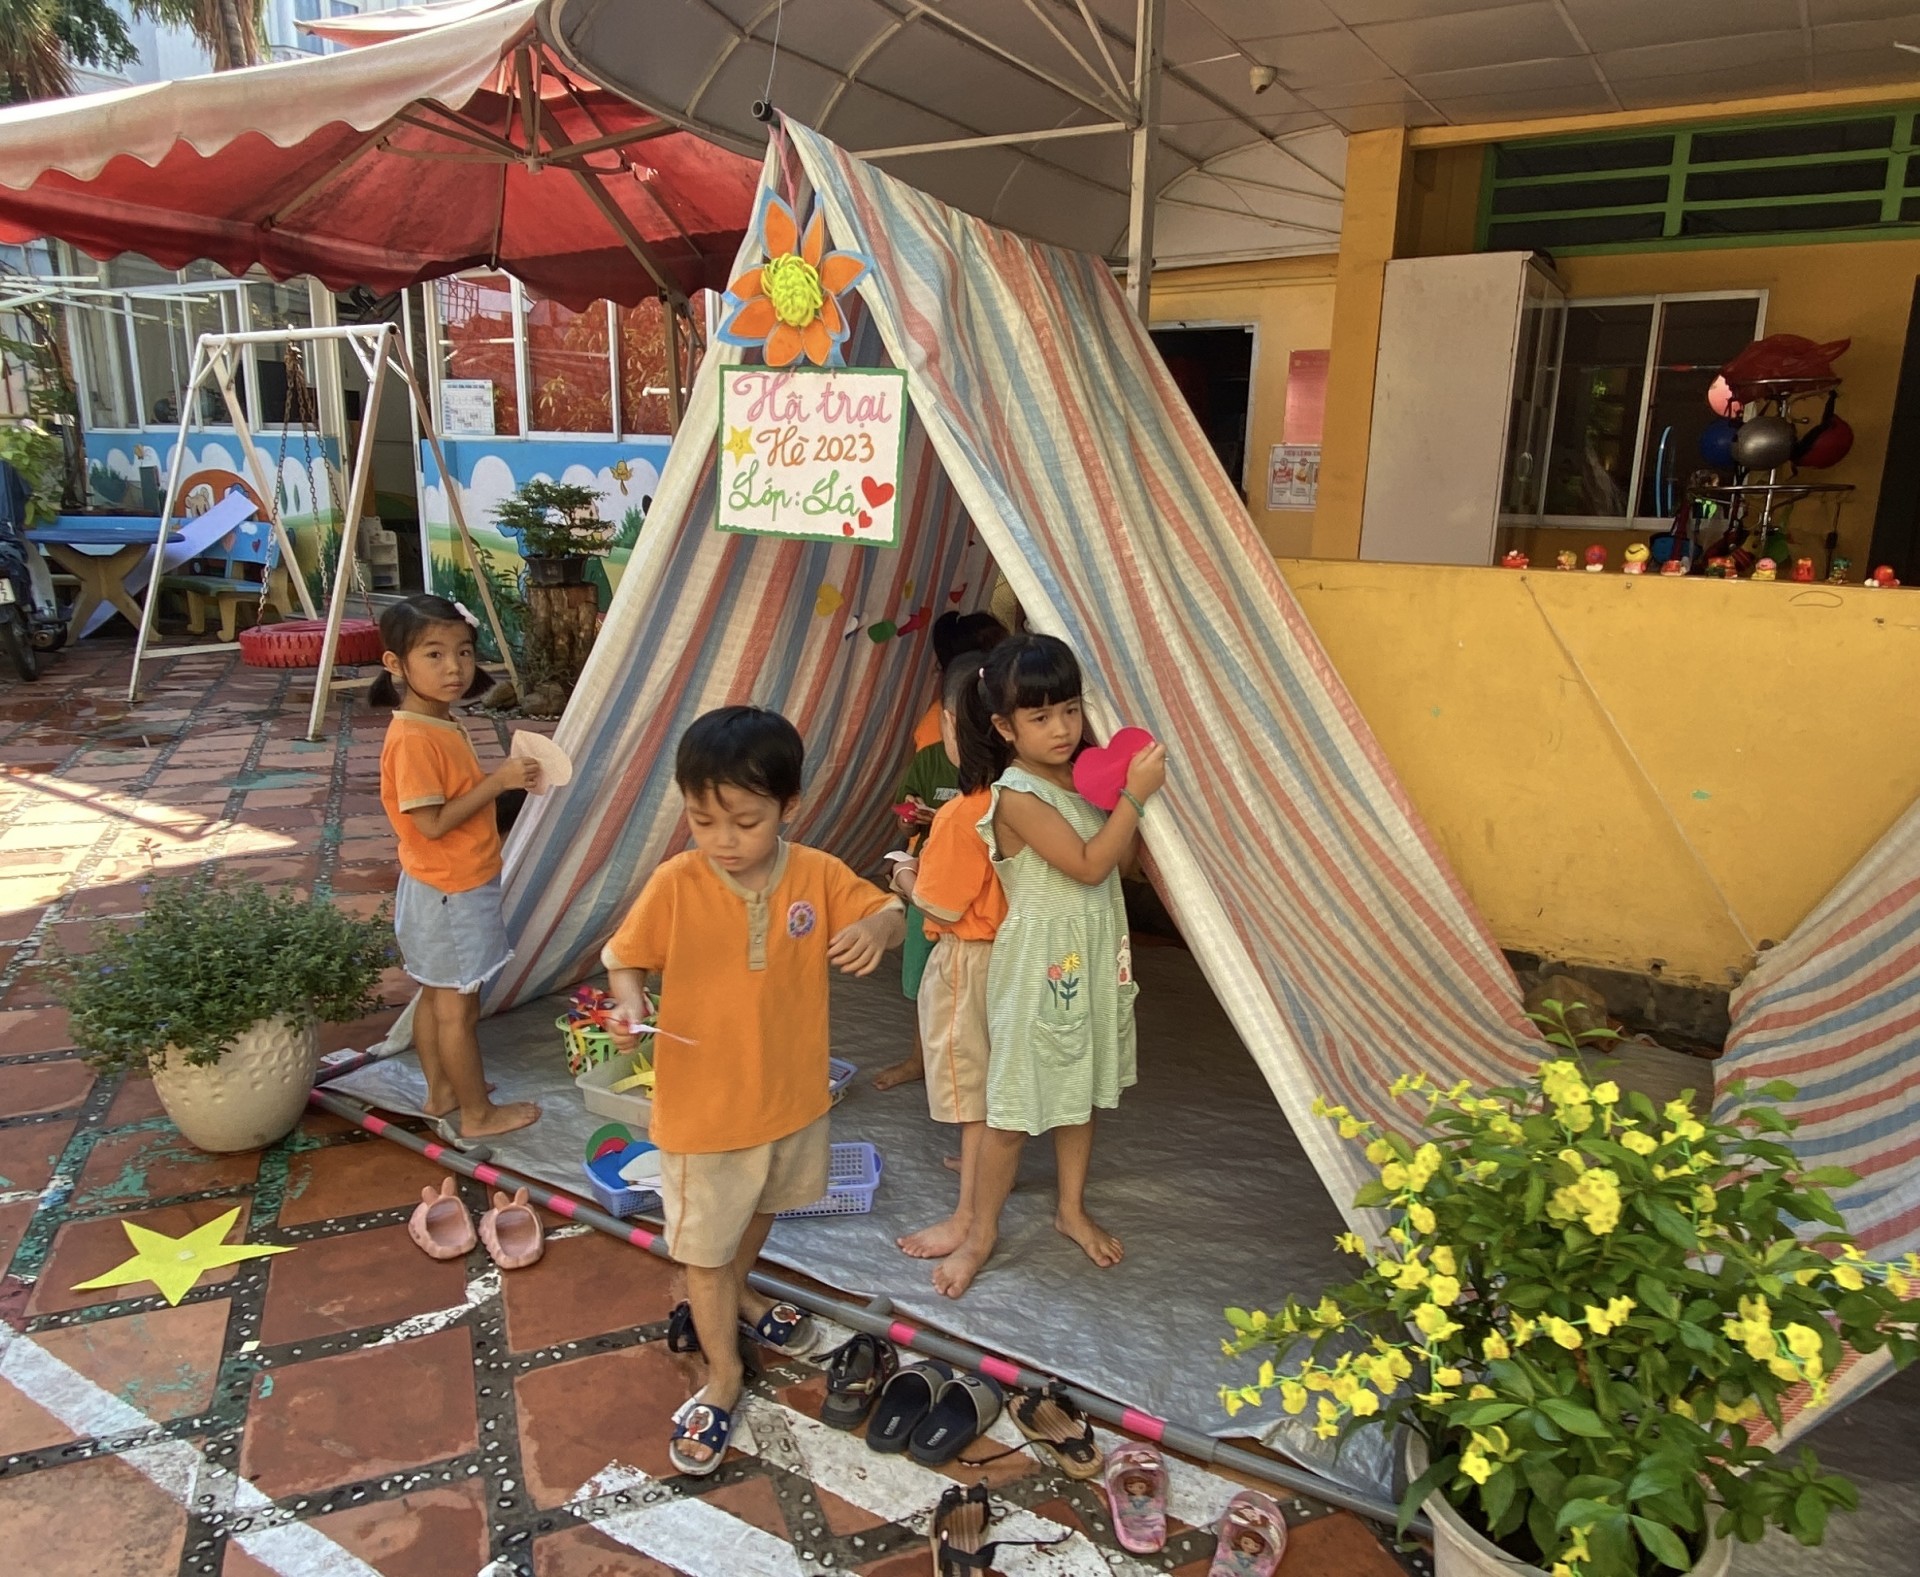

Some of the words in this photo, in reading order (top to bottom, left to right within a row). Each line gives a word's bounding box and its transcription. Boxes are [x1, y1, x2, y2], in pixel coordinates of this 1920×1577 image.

[732, 373, 811, 424] Hội
[815, 382, 893, 428] trại
[756, 425, 810, 468] Hè
[813, 433, 876, 463] 2023
[802, 469, 861, 517] Lá
